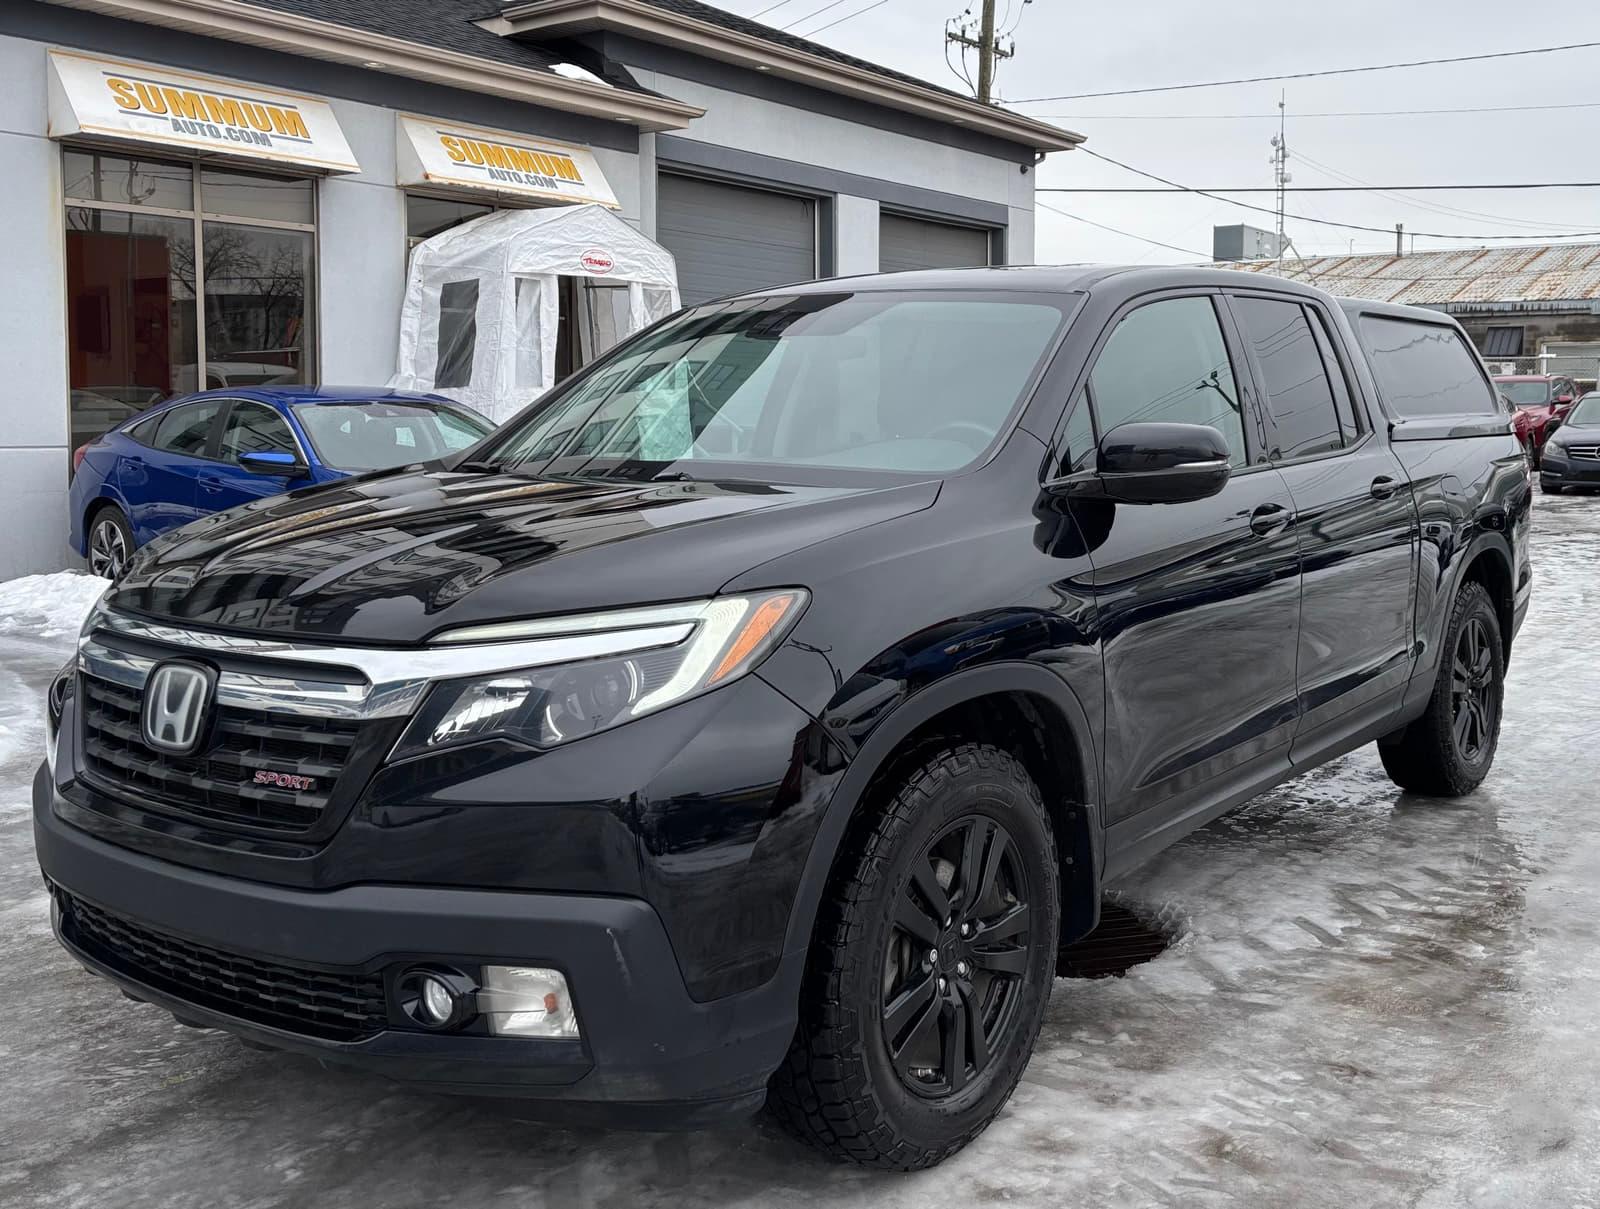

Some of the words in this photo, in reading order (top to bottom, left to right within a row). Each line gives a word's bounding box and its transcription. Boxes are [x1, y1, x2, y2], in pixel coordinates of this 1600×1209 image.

[106, 78, 311, 139] SUMMUM
[171, 118, 273, 147] AUTO.COM
[440, 135, 583, 182] SUMMUM
[487, 168, 559, 190] AUTO.COM
[253, 770, 316, 791] SPORT
